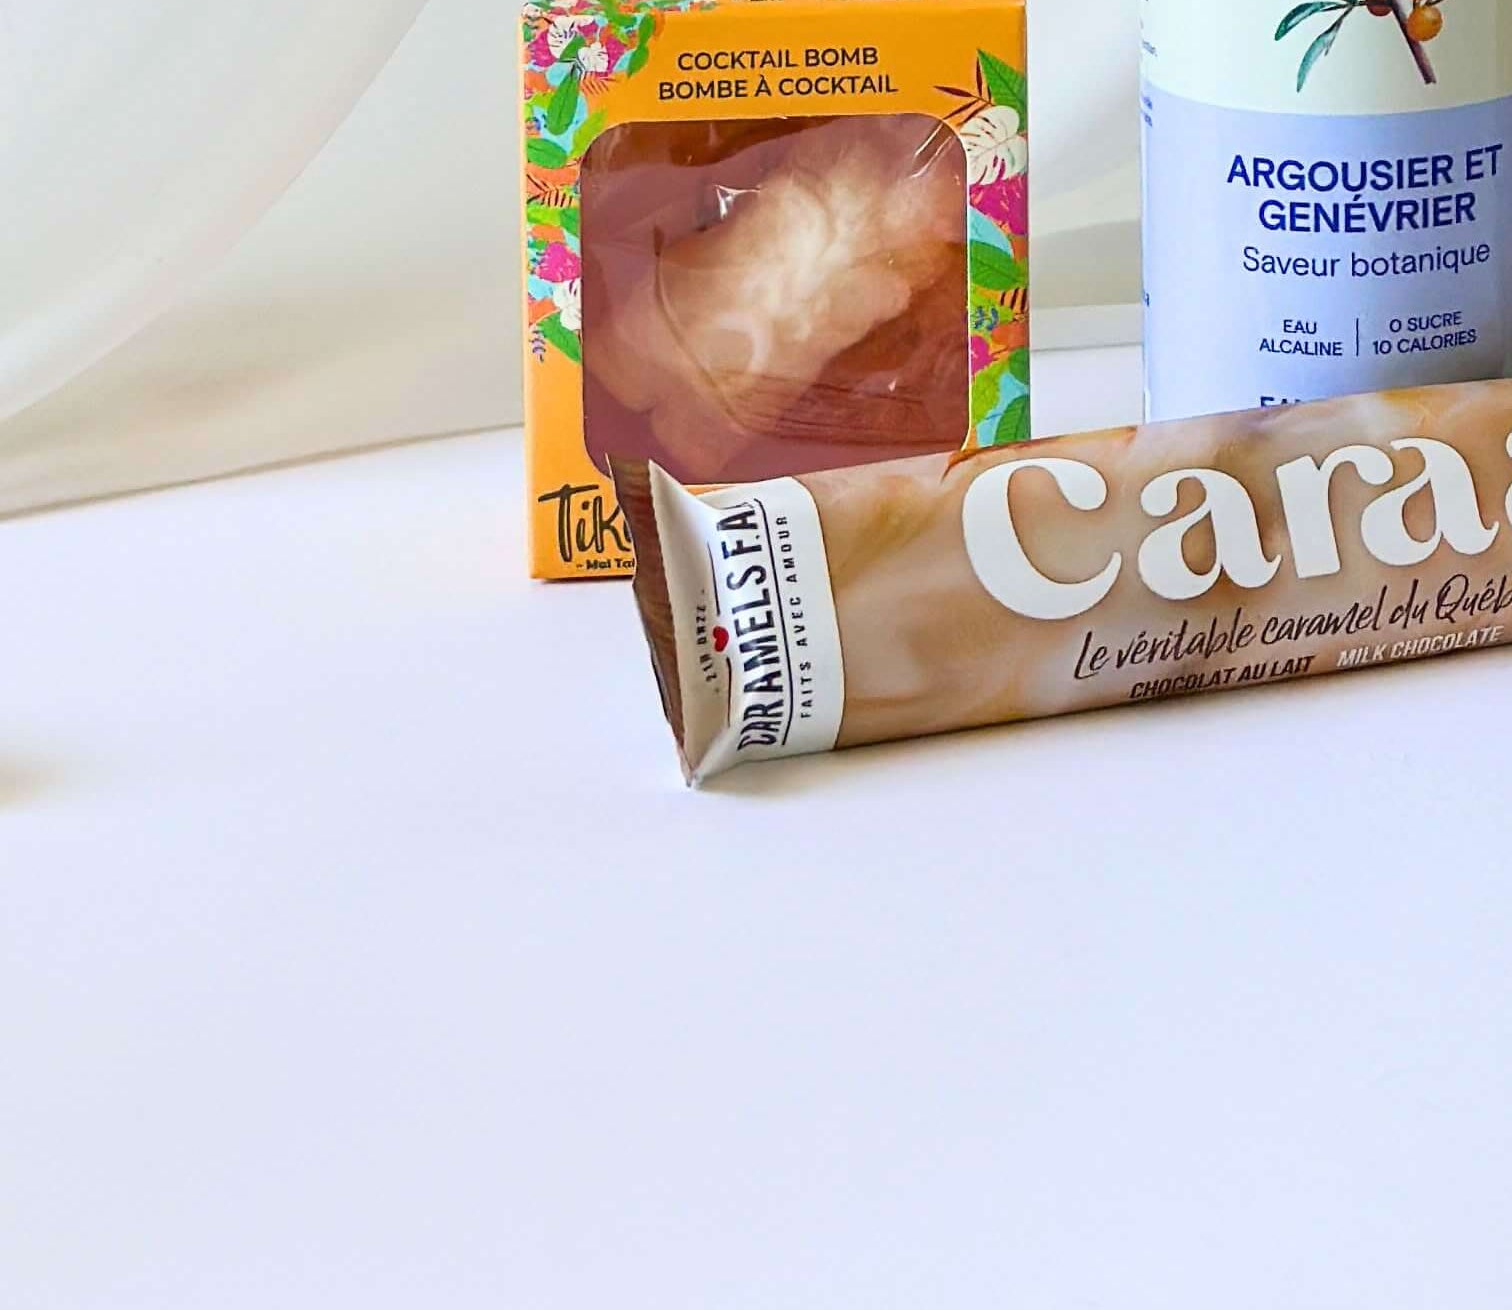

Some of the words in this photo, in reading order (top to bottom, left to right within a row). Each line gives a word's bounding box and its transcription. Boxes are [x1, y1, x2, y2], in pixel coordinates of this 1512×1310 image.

[677, 48, 798, 71] COCKTAIL
[805, 46, 878, 67] BOMB
[658, 79, 748, 100] BOMBE
[754, 74, 772, 97] À
[779, 74, 898, 96] COCKTAIL
[1227, 154, 1453, 192] ARGOUSIER
[1465, 144, 1503, 181] ET
[1259, 192, 1476, 233] GENÉVRIER
[1243, 246, 1340, 278] Saveur
[1351, 242, 1491, 278] botanique
[1283, 319, 1318, 335] EAU
[1373, 341, 1392, 356] 10
[1398, 328, 1477, 354] CALORIES
[1407, 311, 1463, 332] SUCRE
[1259, 339, 1344, 357] ALCALINE
[775, 515, 798, 584] AMOUR
[789, 595, 809, 647] AVEC
[1074, 631, 1110, 680] Le
[1116, 606, 1257, 670] véritable
[1261, 584, 1388, 645] caramel
[1389, 578, 1430, 629] du
[726, 565, 784, 751] CARAMELS
[1337, 640, 1391, 668] MILK
[1391, 624, 1505, 660] CHOCOLATE
[799, 661, 815, 719] FAITS
[1129, 667, 1237, 700] CHOCOLAT
[1238, 663, 1268, 683] AU
[1269, 655, 1316, 678] LAIT
